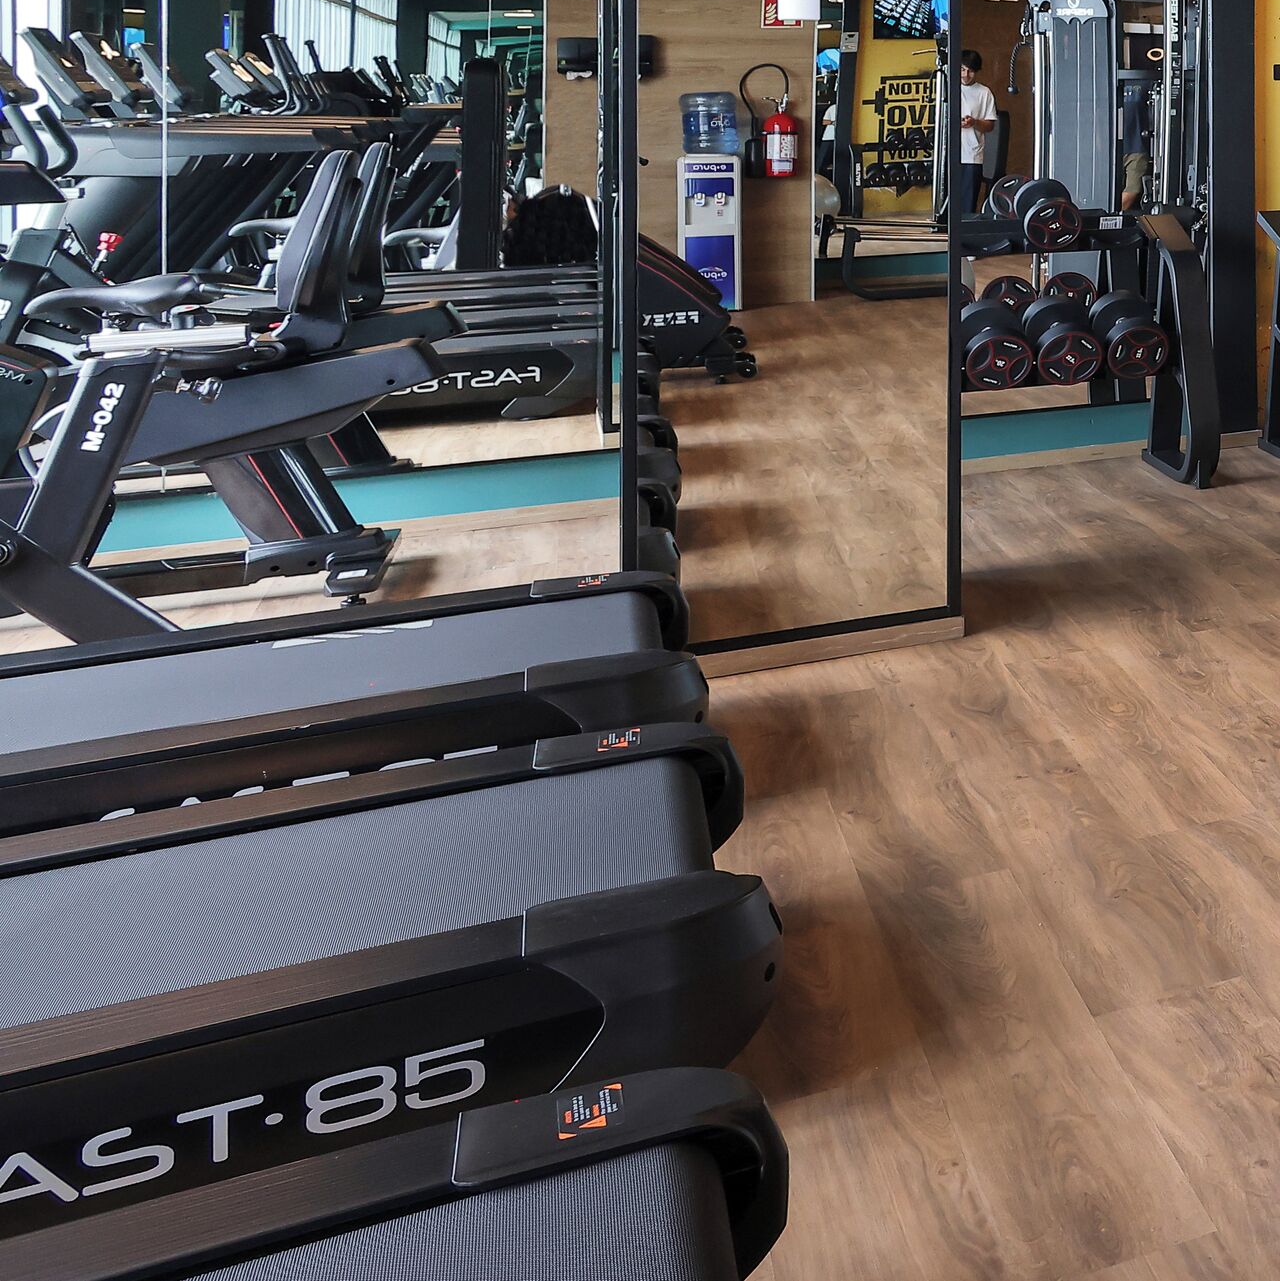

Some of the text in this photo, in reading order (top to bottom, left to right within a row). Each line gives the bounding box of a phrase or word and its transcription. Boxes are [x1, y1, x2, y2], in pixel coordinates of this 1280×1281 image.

[888, 81, 937, 96] NOTH
[887, 105, 936, 127] OV
[80, 382, 126, 452] M-042
